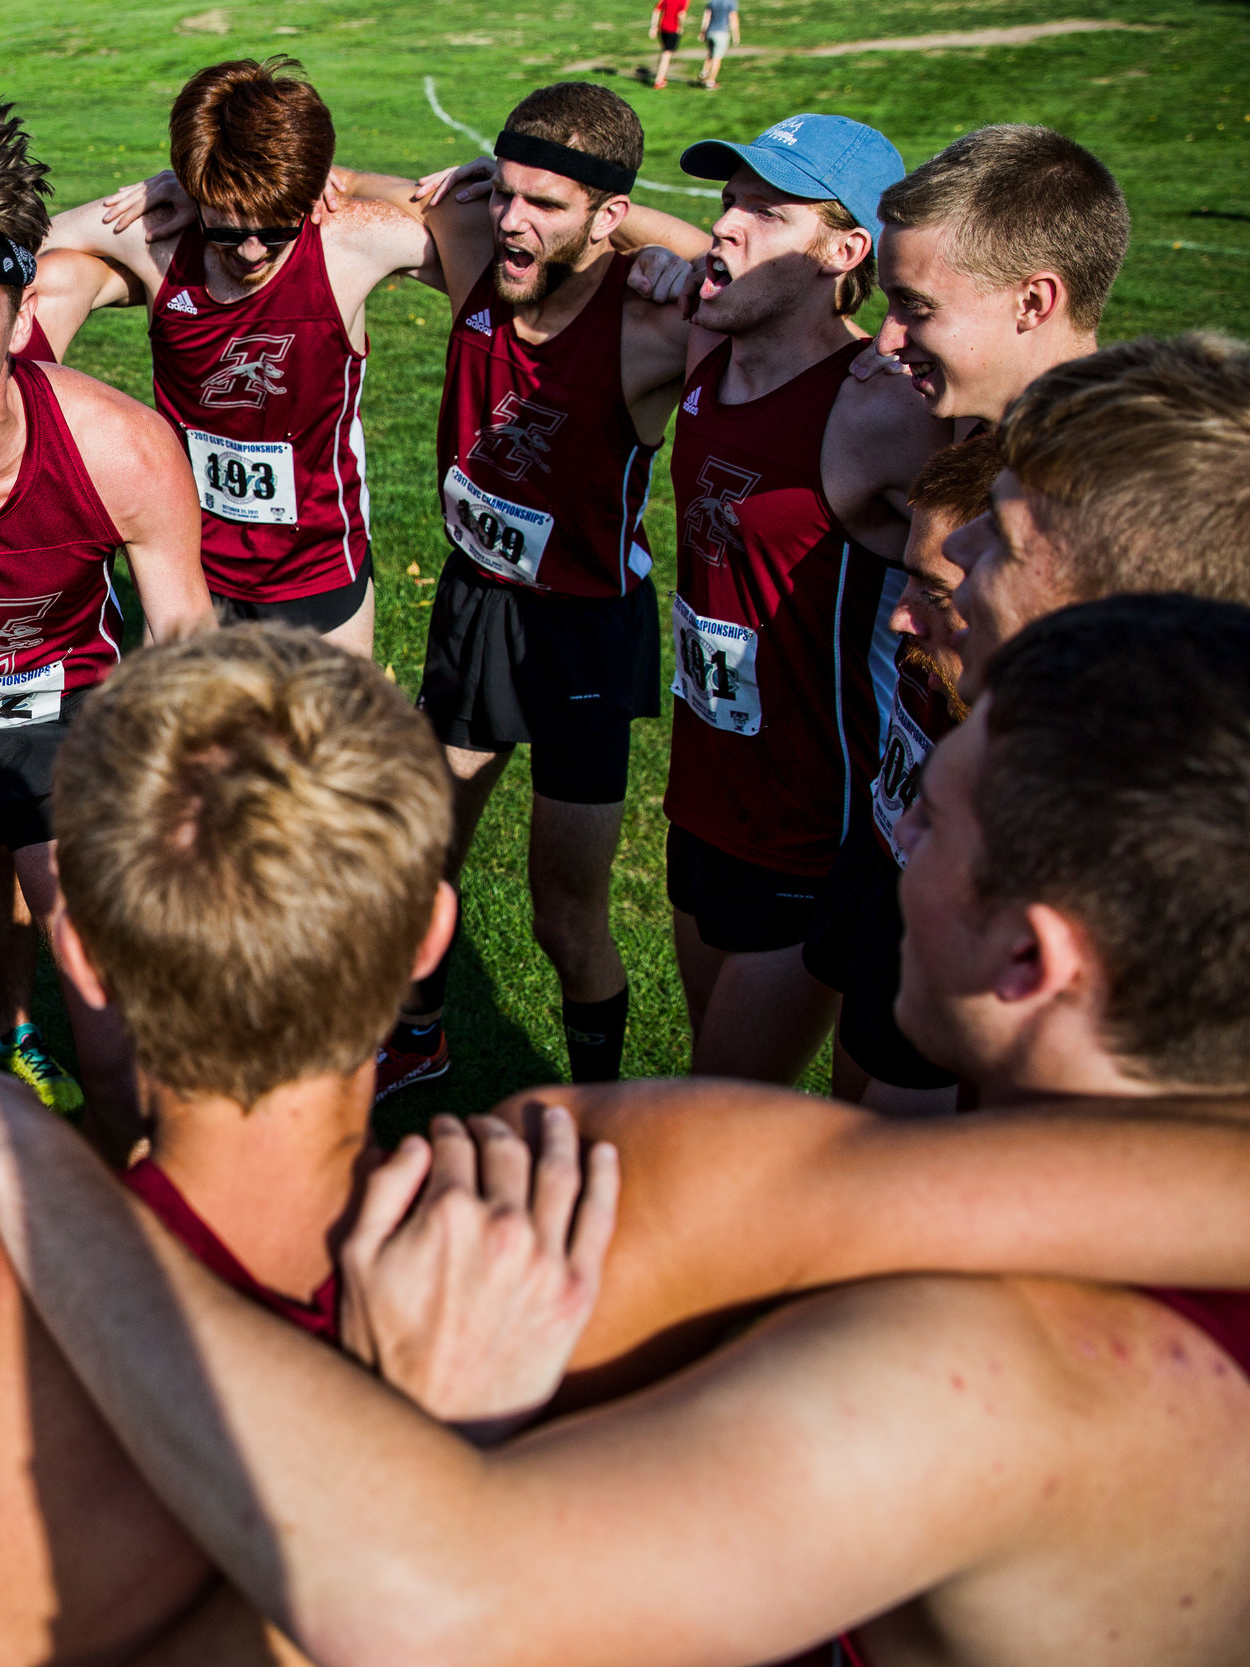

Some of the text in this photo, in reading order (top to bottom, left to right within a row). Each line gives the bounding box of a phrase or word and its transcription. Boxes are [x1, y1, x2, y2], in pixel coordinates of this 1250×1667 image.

[166, 302, 198, 315] adidas
[194, 431, 208, 442] 2017
[225, 439, 283, 453] CHAMPIONSHIPS
[207, 452, 276, 500] 193
[453, 471, 468, 487] 2017
[481, 493, 545, 526] CHAMPIONSHIPS
